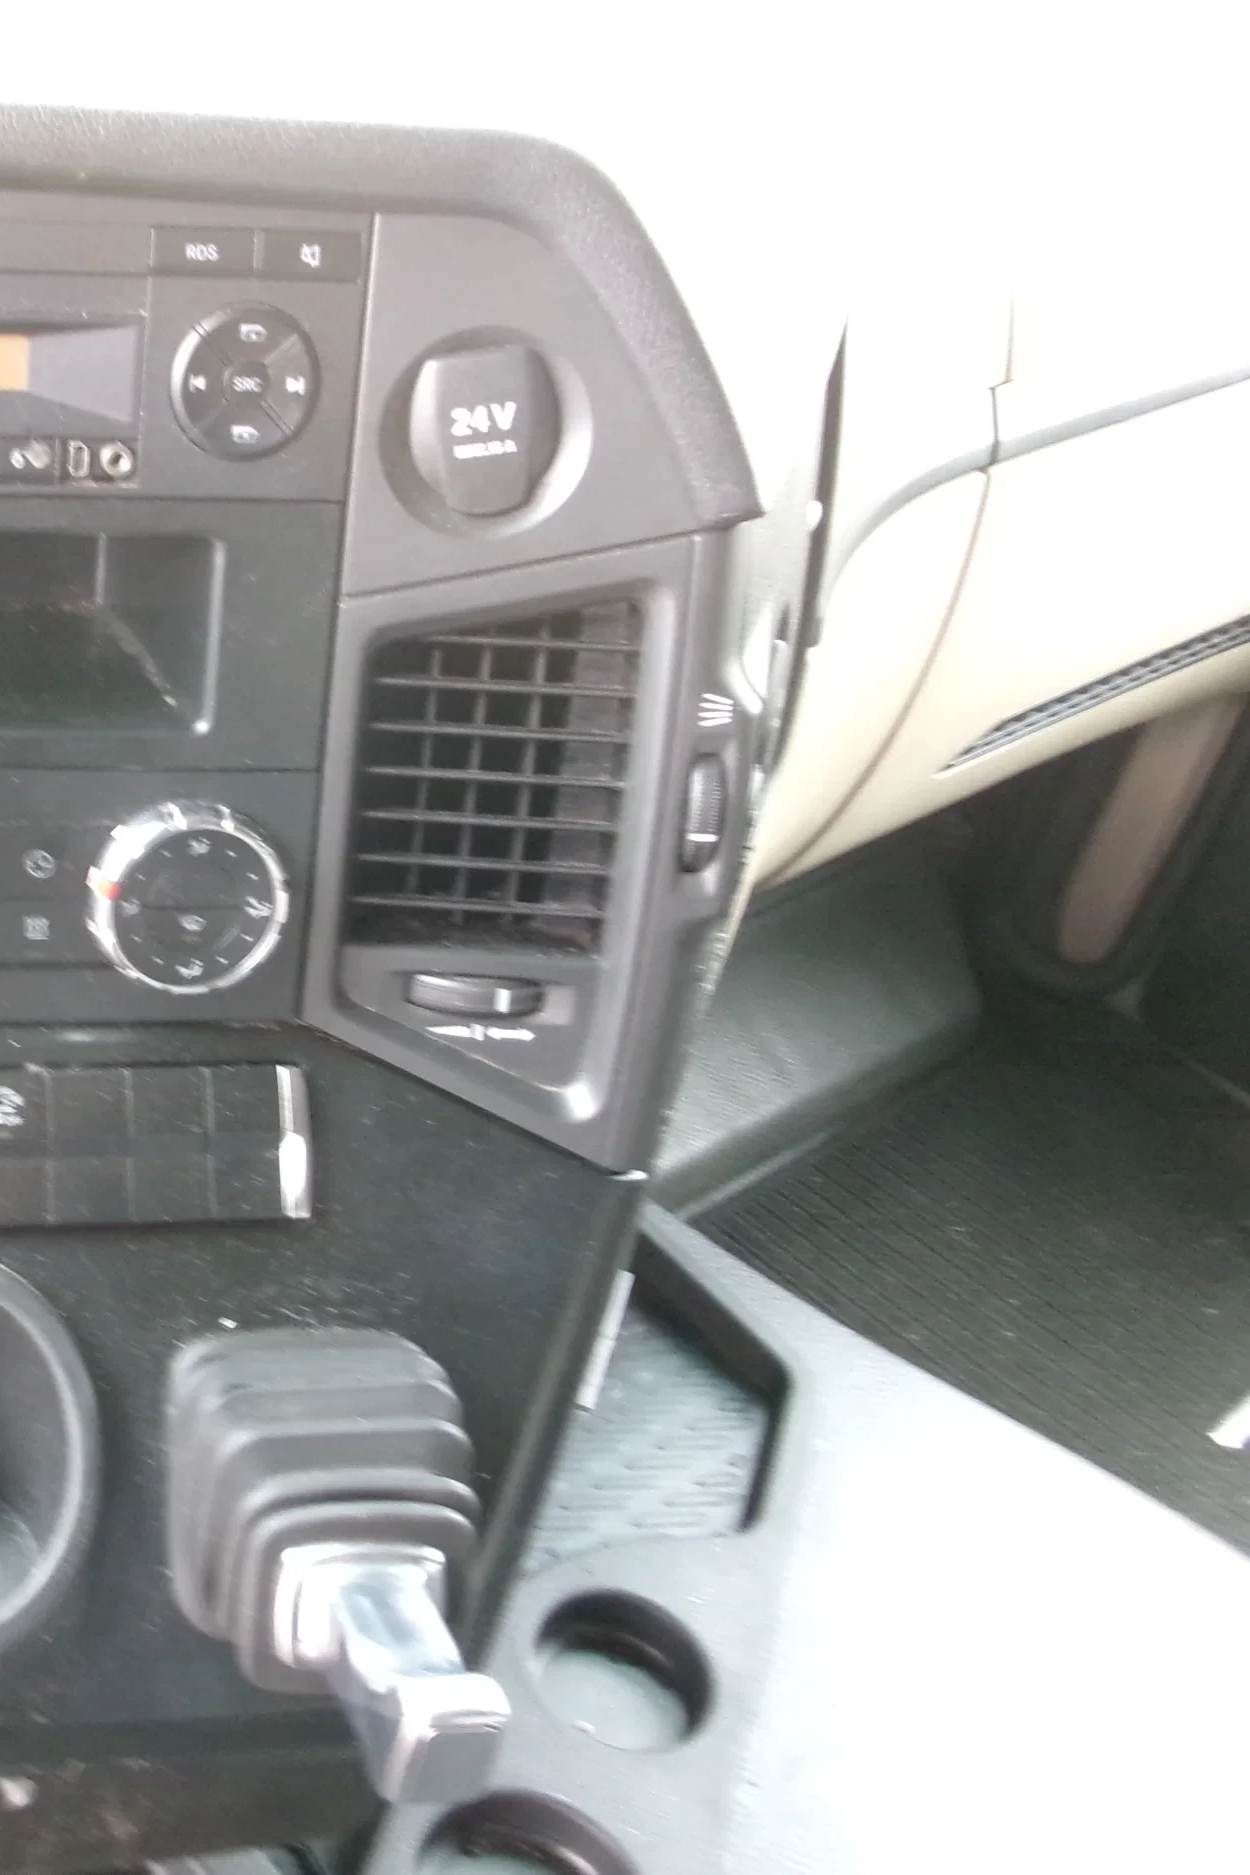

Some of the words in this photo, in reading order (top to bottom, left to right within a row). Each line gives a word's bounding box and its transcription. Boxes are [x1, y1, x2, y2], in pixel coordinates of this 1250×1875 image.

[185, 241, 220, 262] RDS
[231, 375, 264, 393] SRC
[450, 401, 517, 436] 24V
